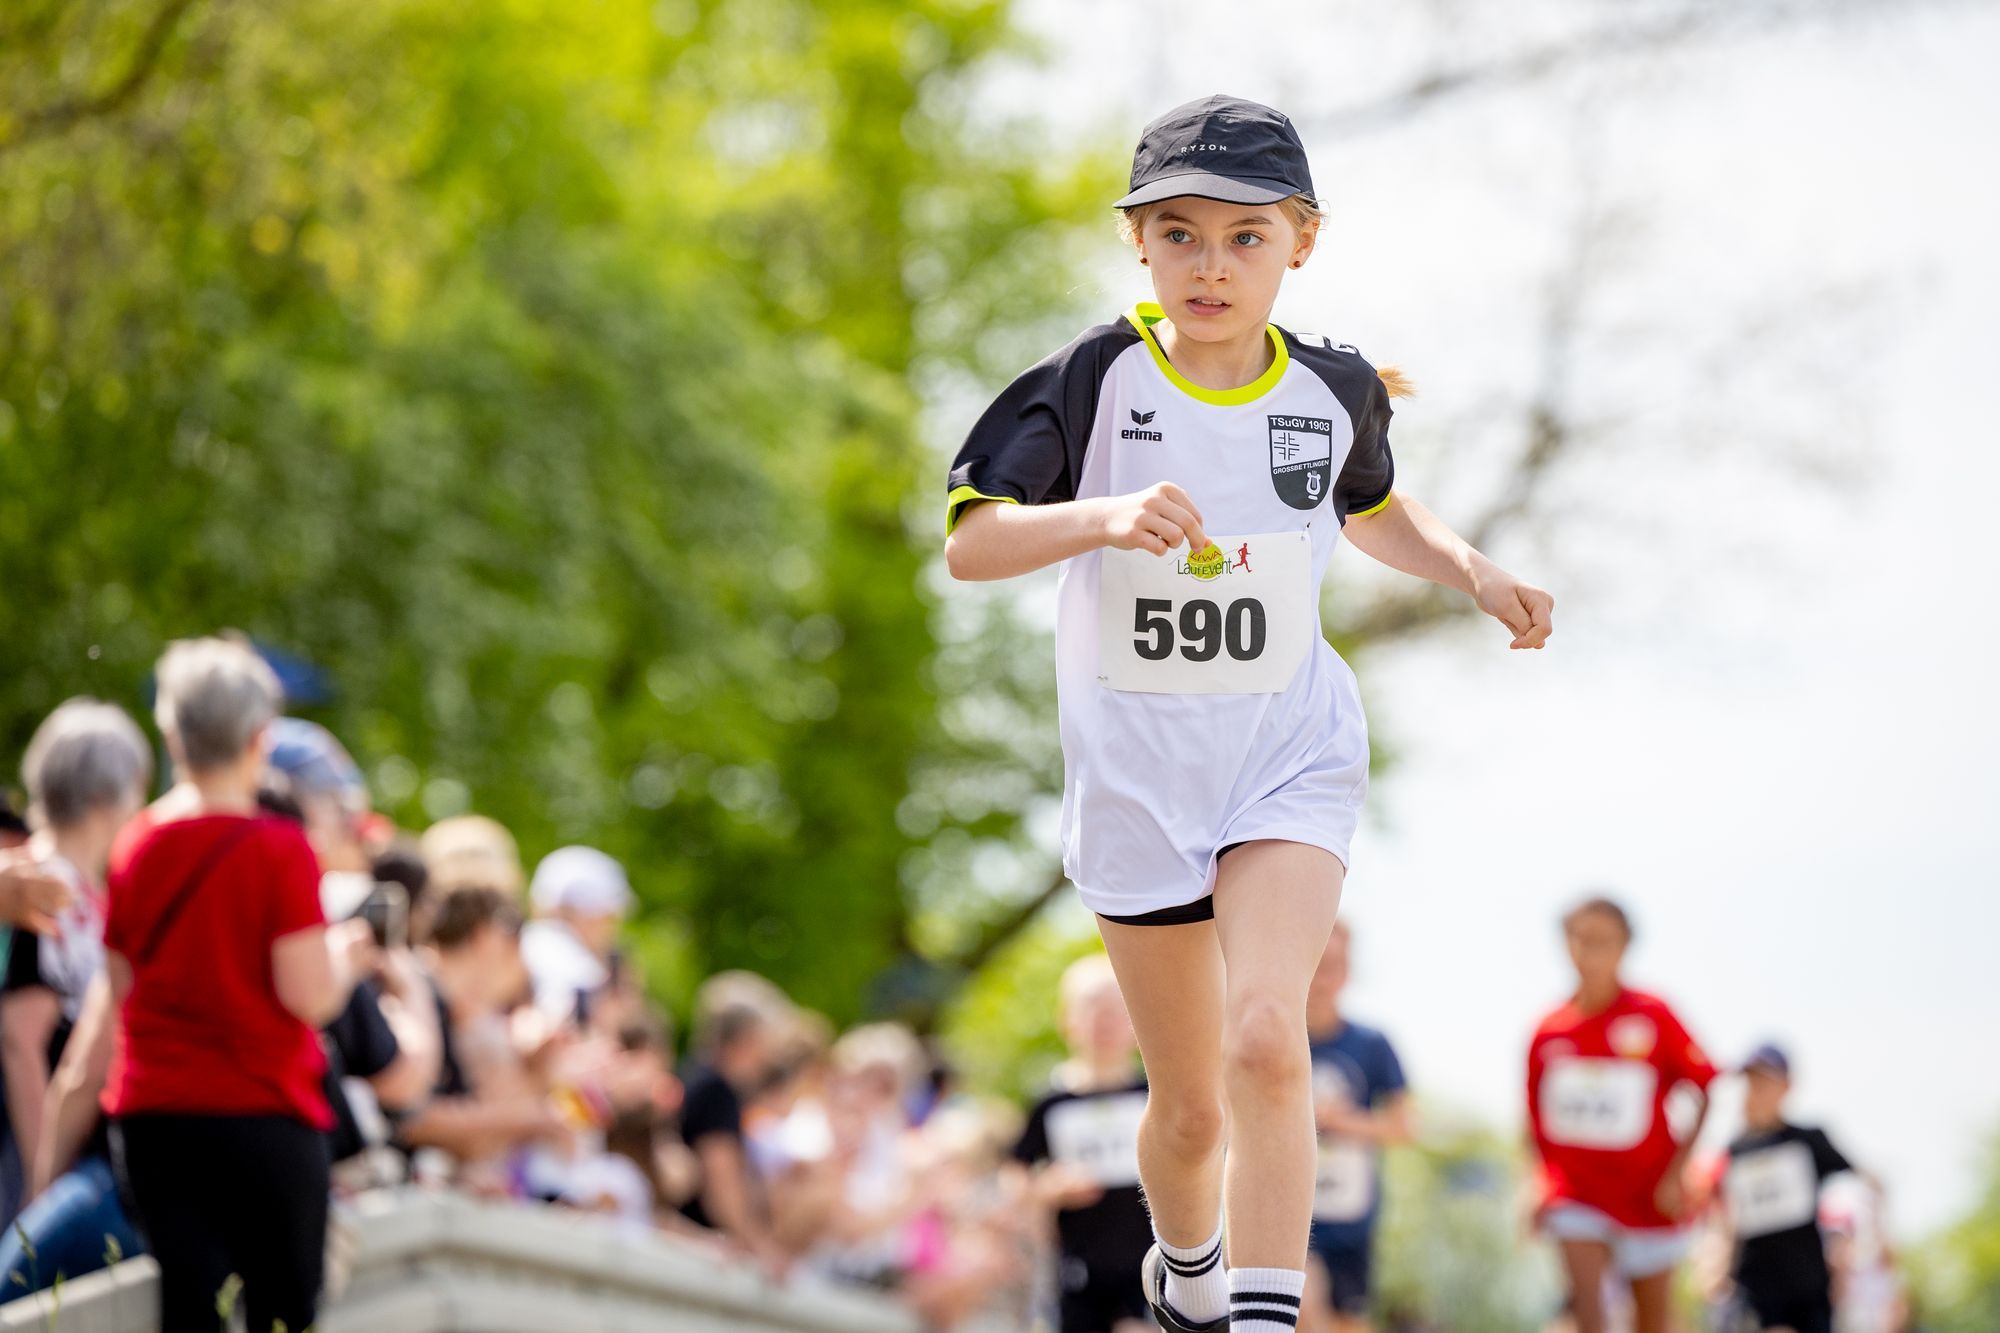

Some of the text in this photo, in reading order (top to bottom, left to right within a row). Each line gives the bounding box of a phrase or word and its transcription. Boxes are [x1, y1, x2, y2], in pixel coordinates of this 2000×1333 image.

[1181, 144, 1227, 153] RYZON
[1270, 417, 1330, 431] TSuGV 1903
[1121, 428, 1162, 442] erima
[1273, 460, 1329, 474] GROSSBETTLINGEN
[1134, 598, 1266, 662] 590
